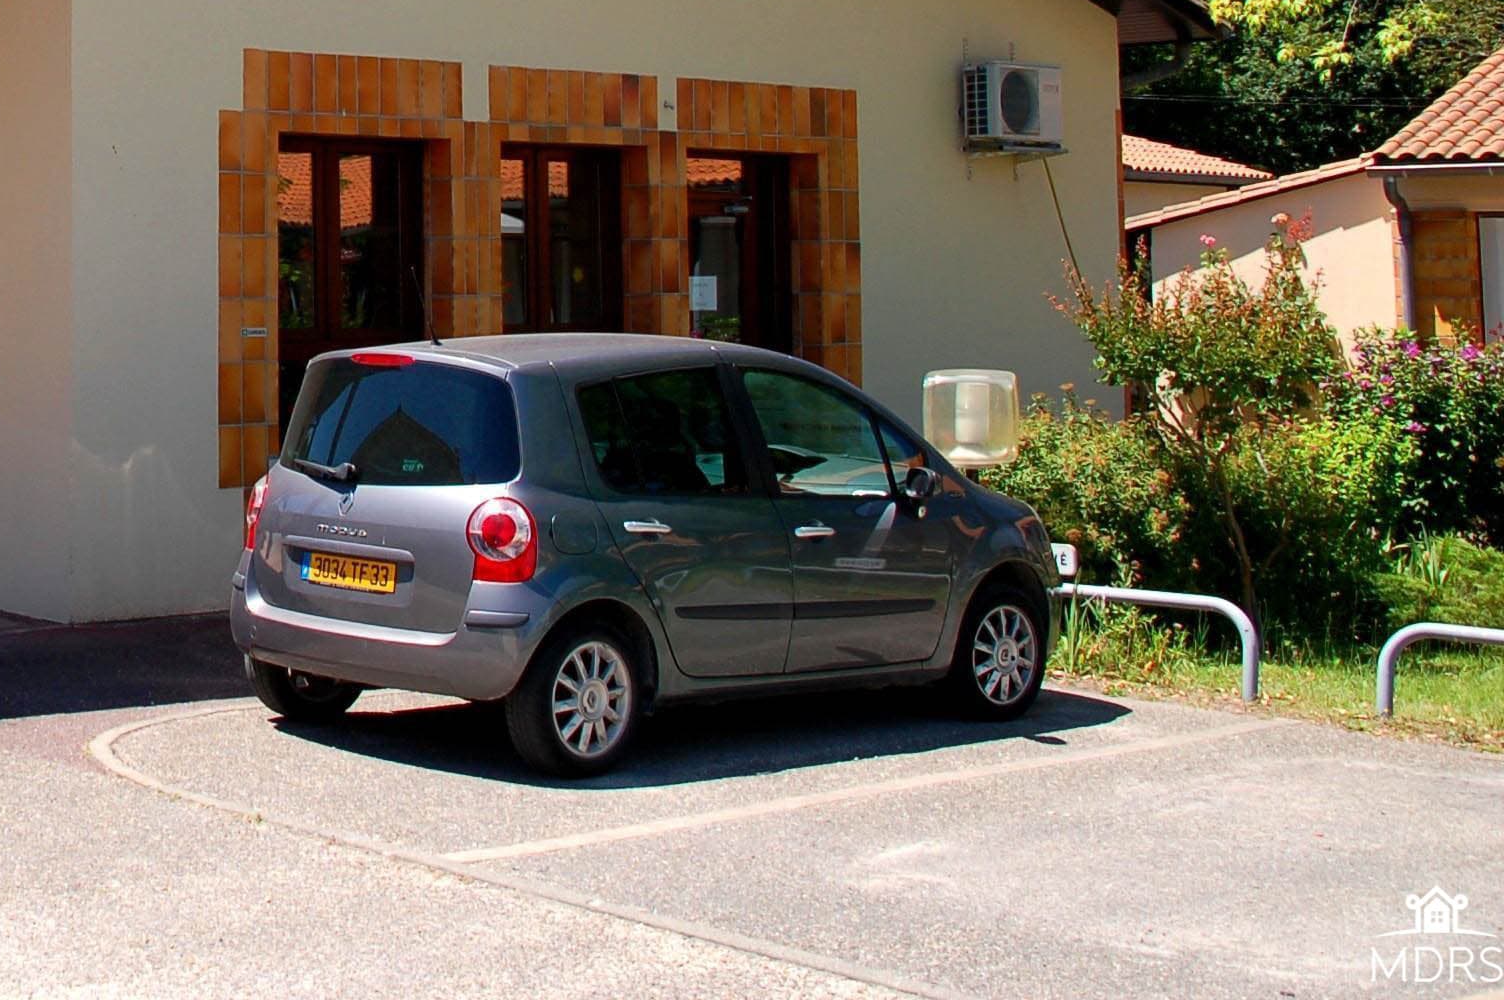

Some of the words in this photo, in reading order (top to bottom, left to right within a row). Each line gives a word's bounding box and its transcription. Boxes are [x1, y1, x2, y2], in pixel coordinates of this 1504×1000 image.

[314, 557, 347, 580] 3034
[352, 562, 369, 584] TF
[371, 566, 389, 586] 33
